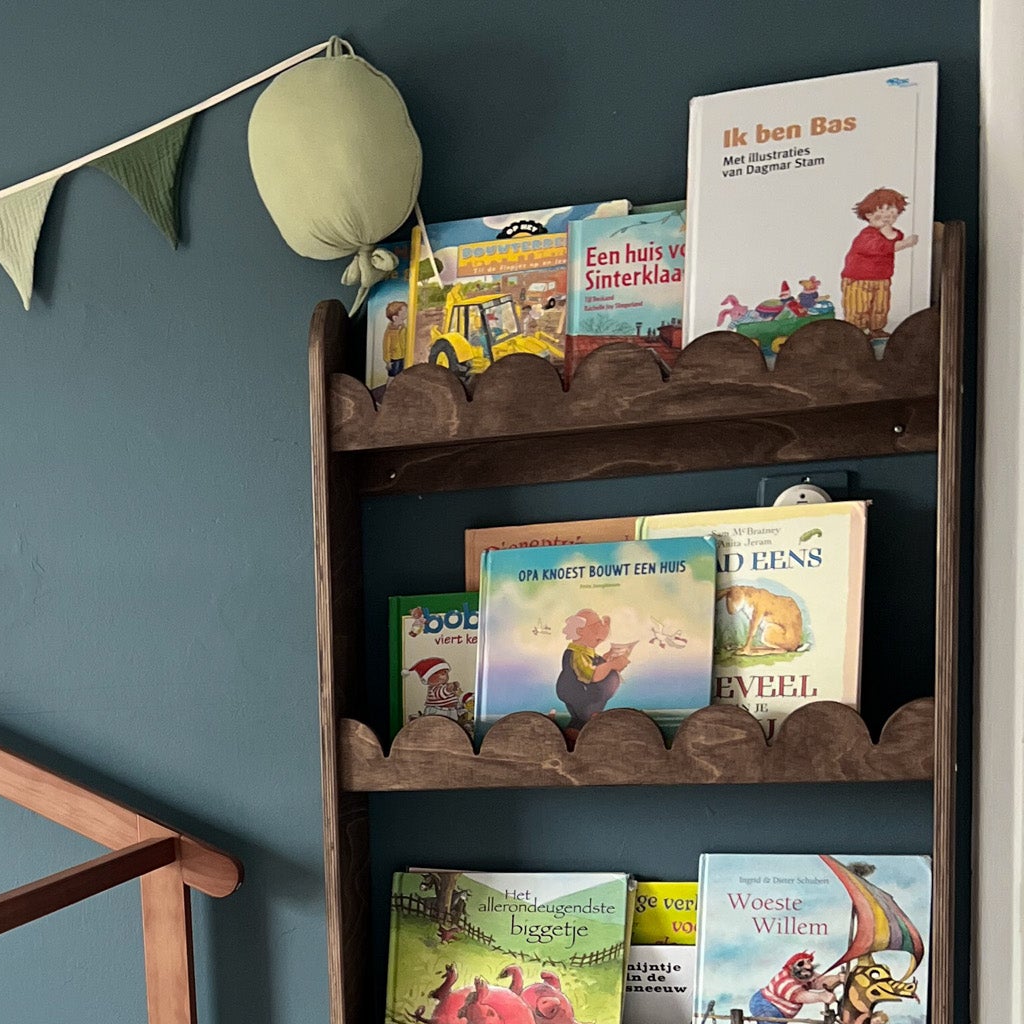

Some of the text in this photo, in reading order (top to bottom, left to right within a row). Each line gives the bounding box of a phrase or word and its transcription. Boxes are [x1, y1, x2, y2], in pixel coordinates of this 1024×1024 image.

[723, 116, 857, 148] Ik ben Bas
[723, 146, 810, 166] Met illustraties
[722, 155, 825, 178] van Dagmar Stam
[506, 223, 538, 235] OP HET
[586, 246, 620, 267] Een
[625, 241, 663, 263] huis
[585, 264, 685, 291] Sinterklaa
[718, 538, 772, 548] Anita Jeram
[751, 548, 822, 571] EENS
[518, 560, 686, 582] OPA KNOEST BOUWT EEN HUIS
[435, 634, 463, 645] viert
[713, 675, 817, 699] EVEEL
[754, 703, 768, 713] JE
[505, 889, 531, 900] Het
[664, 894, 698, 911] ver
[727, 893, 802, 911] Woeste
[478, 897, 616, 919] allerondeugendste
[510, 914, 589, 950] biggetje
[672, 921, 697, 934] vo
[752, 916, 828, 935] Willem
[627, 962, 681, 973] nijntje
[647, 973, 666, 982] de
[625, 985, 687, 993] sneeuw
